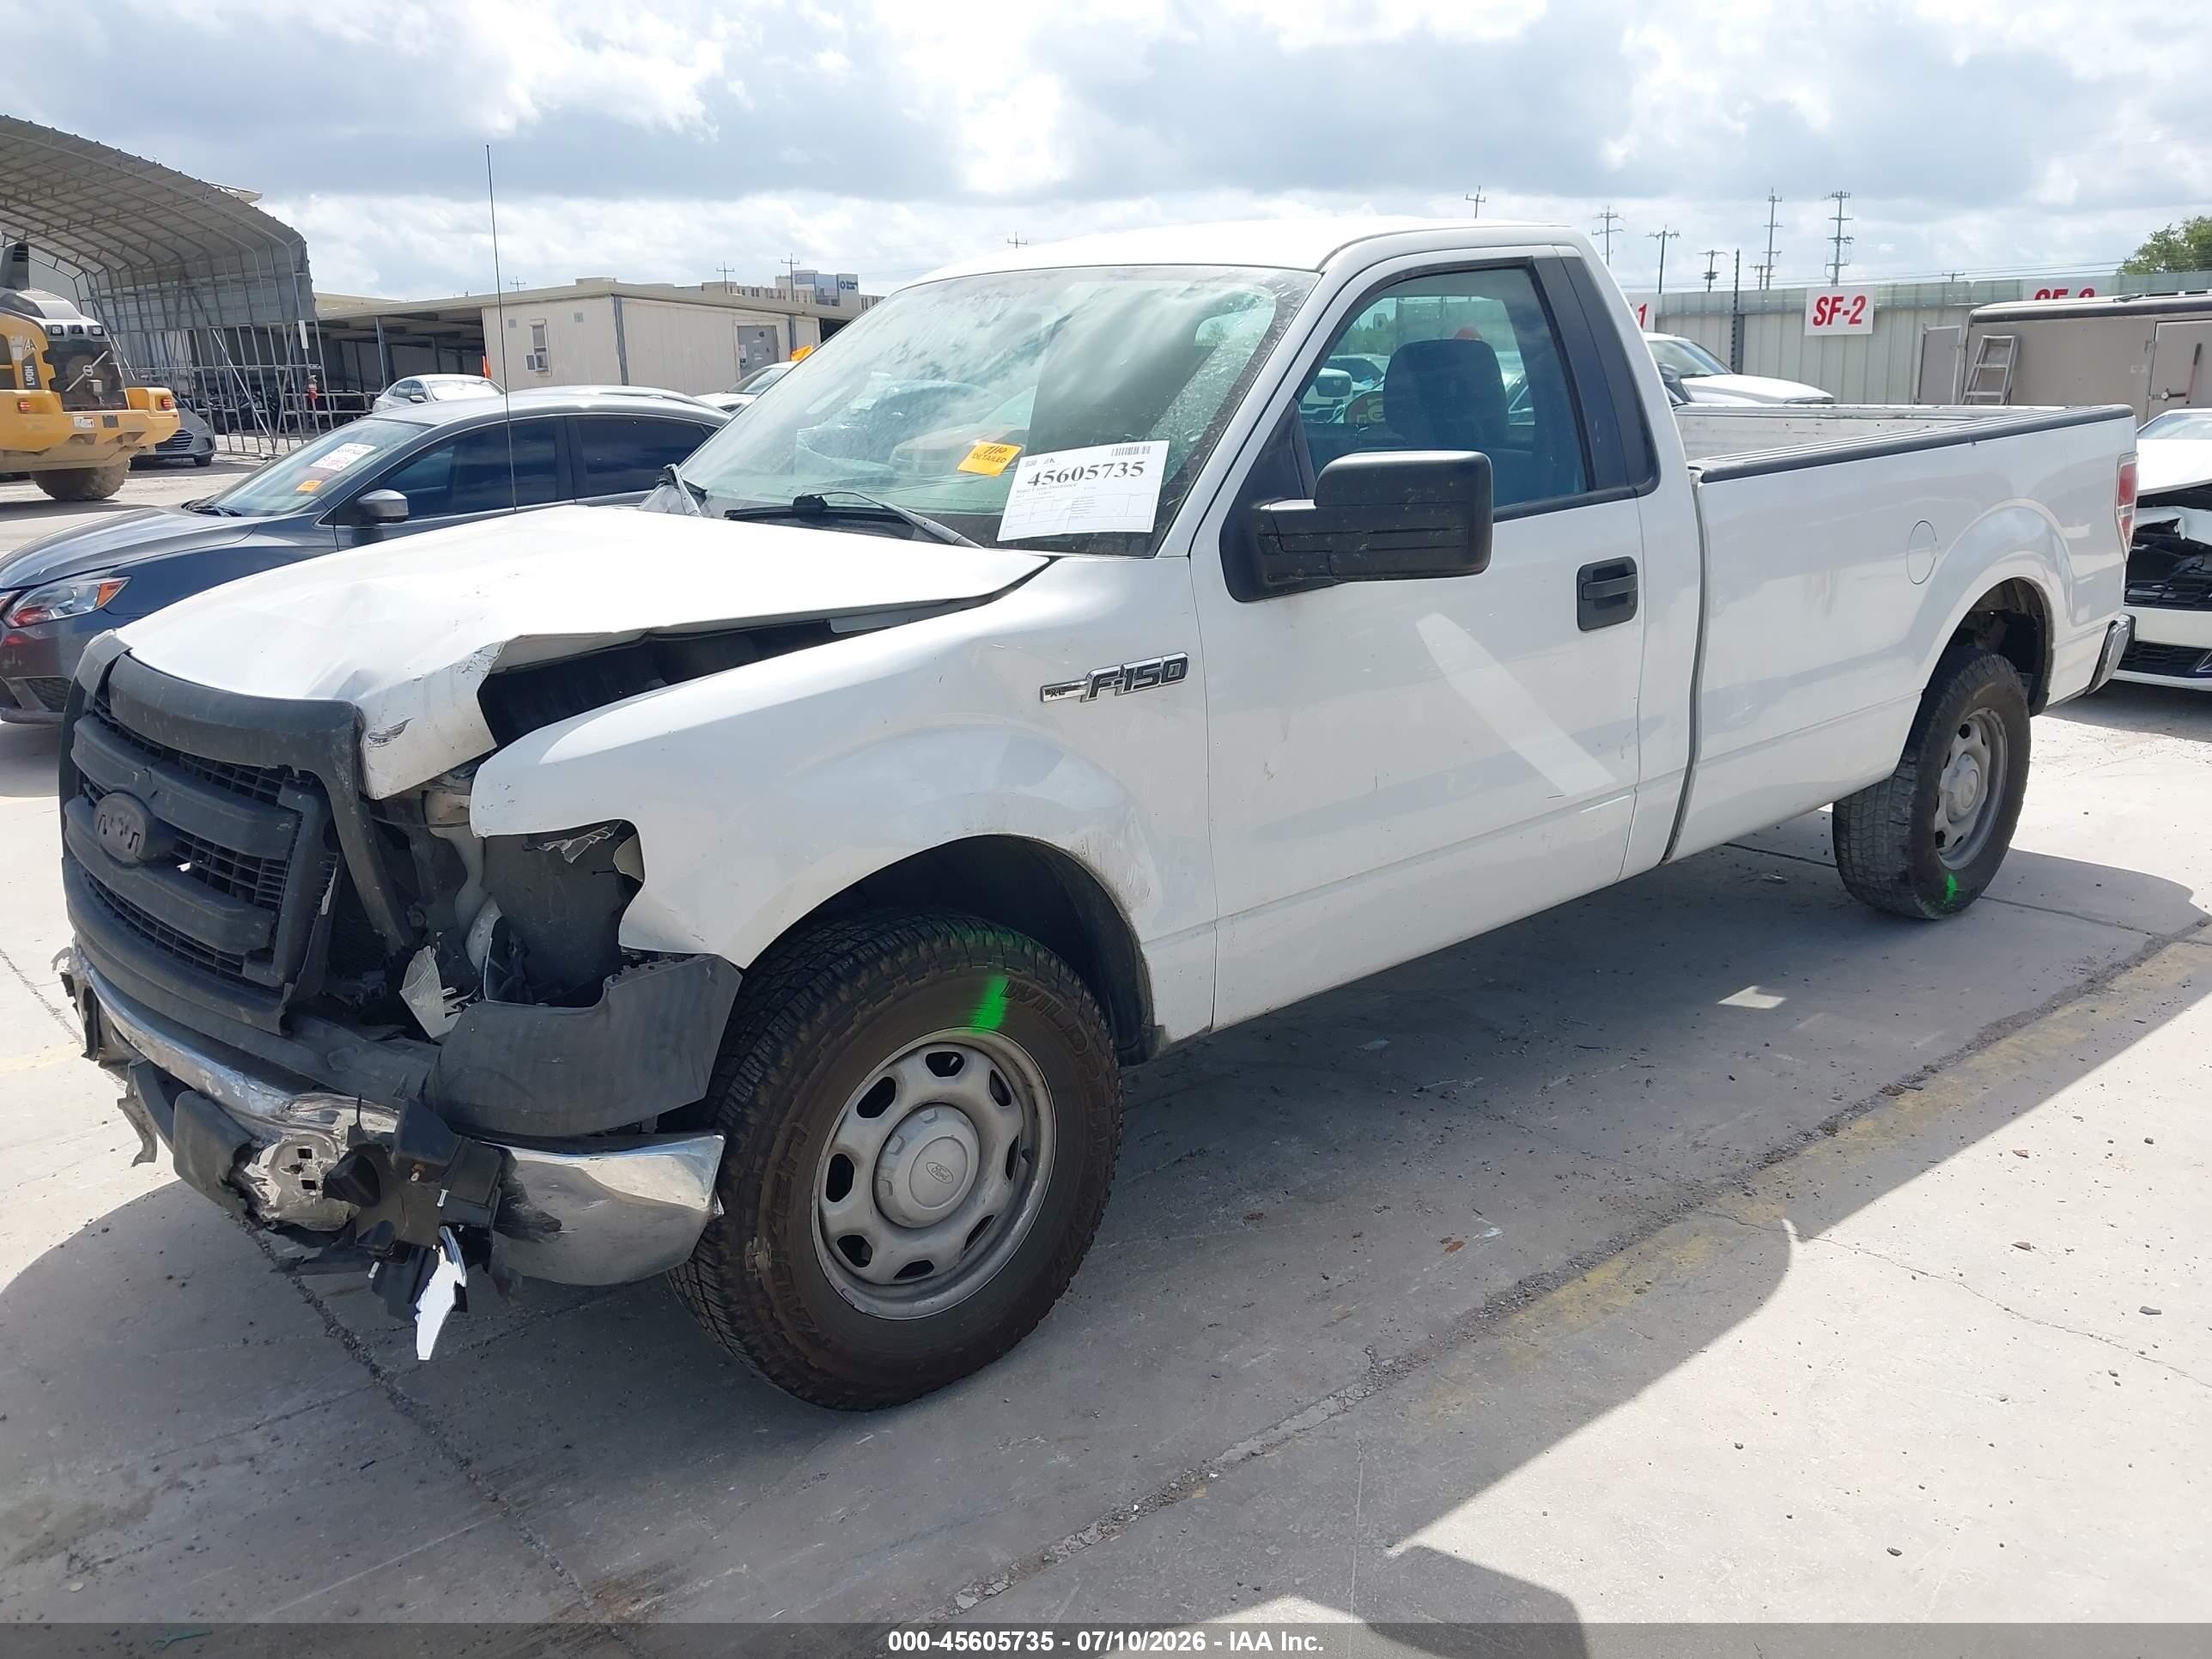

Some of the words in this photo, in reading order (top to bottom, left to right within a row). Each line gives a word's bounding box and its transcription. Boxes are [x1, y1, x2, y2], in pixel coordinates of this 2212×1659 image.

[1813, 295, 1867, 326] SF-2
[24, 365, 36, 386] L90H
[971, 453, 1007, 464] DETAILED
[1027, 461, 1146, 486] 45605735
[1080, 652, 1189, 702] F-150
